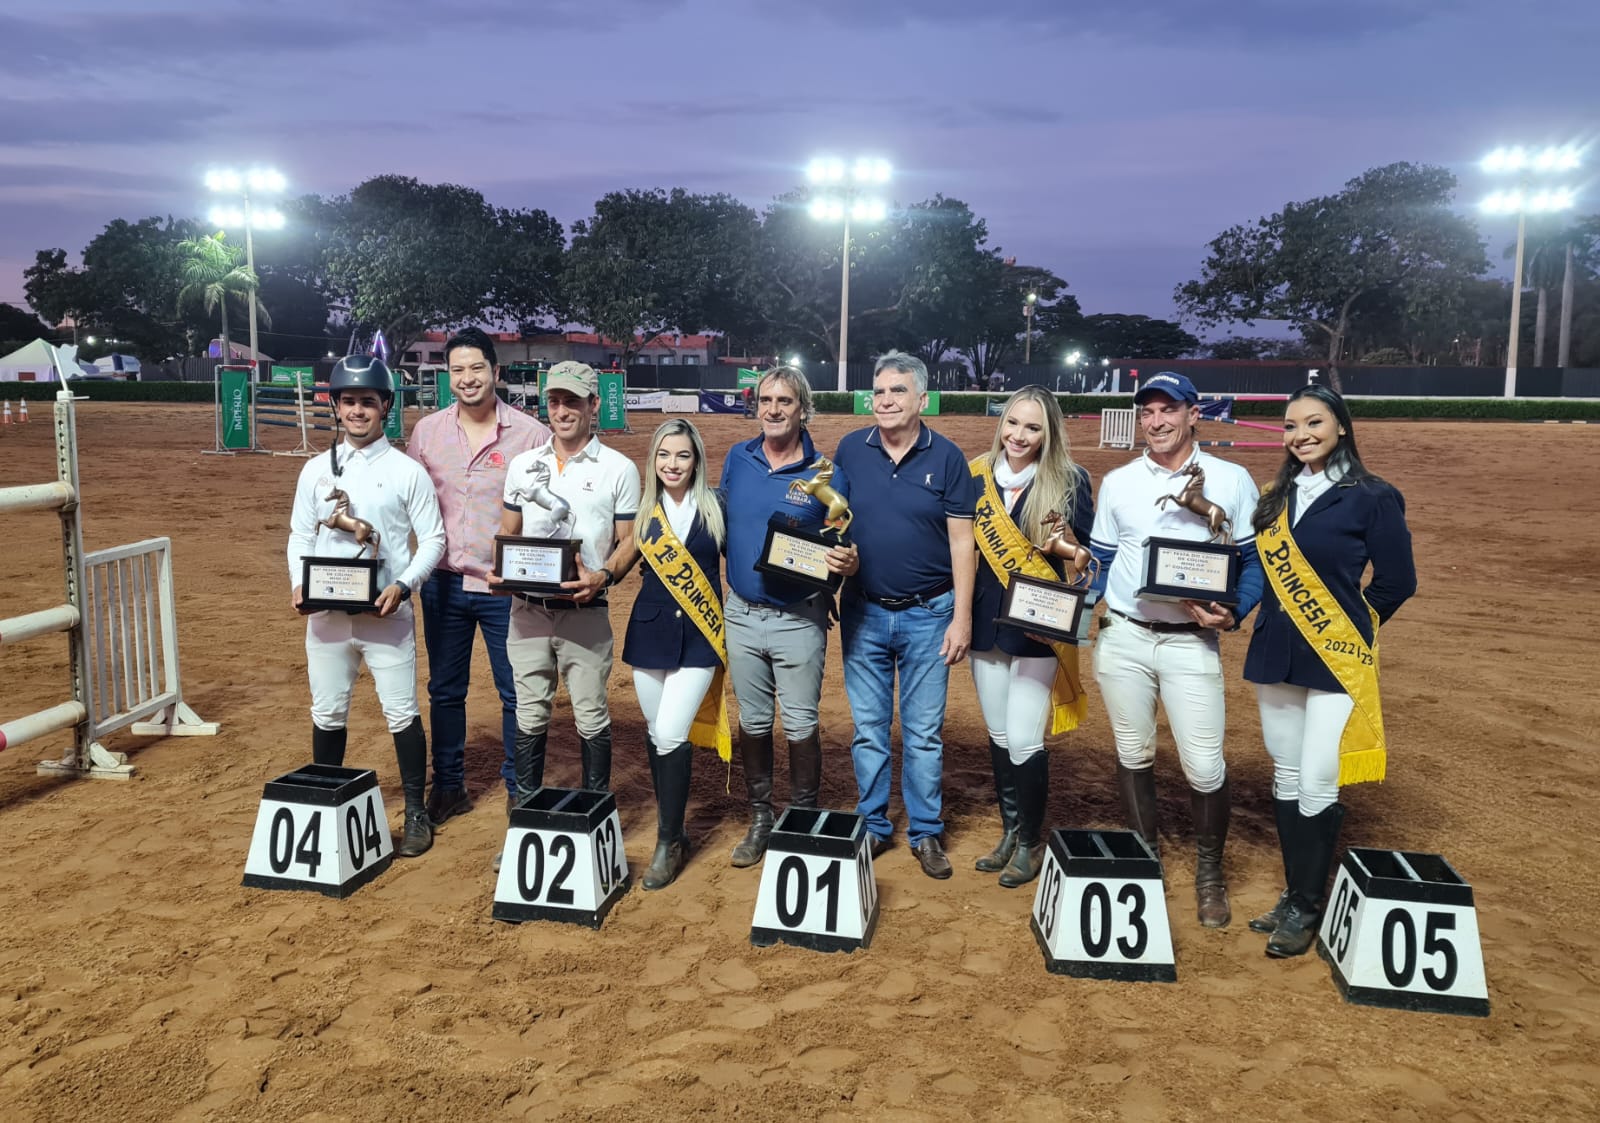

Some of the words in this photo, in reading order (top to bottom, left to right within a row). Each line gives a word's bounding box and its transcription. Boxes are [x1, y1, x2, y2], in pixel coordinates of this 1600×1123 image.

[231, 388, 243, 431] IMPÉRIO
[607, 382, 618, 421] IMPÉRIO
[975, 500, 1009, 560] RAINHA
[665, 562, 723, 637] PRINCESA
[1264, 540, 1332, 634] PRINCESA
[269, 806, 322, 878] 04
[346, 794, 382, 872] 04
[517, 832, 576, 906] 02
[596, 817, 622, 896] 02
[776, 855, 842, 933] 01
[1039, 856, 1060, 940] 03
[1080, 881, 1148, 960] 03
[1329, 877, 1359, 964] 05
[1381, 907, 1458, 992] 05
